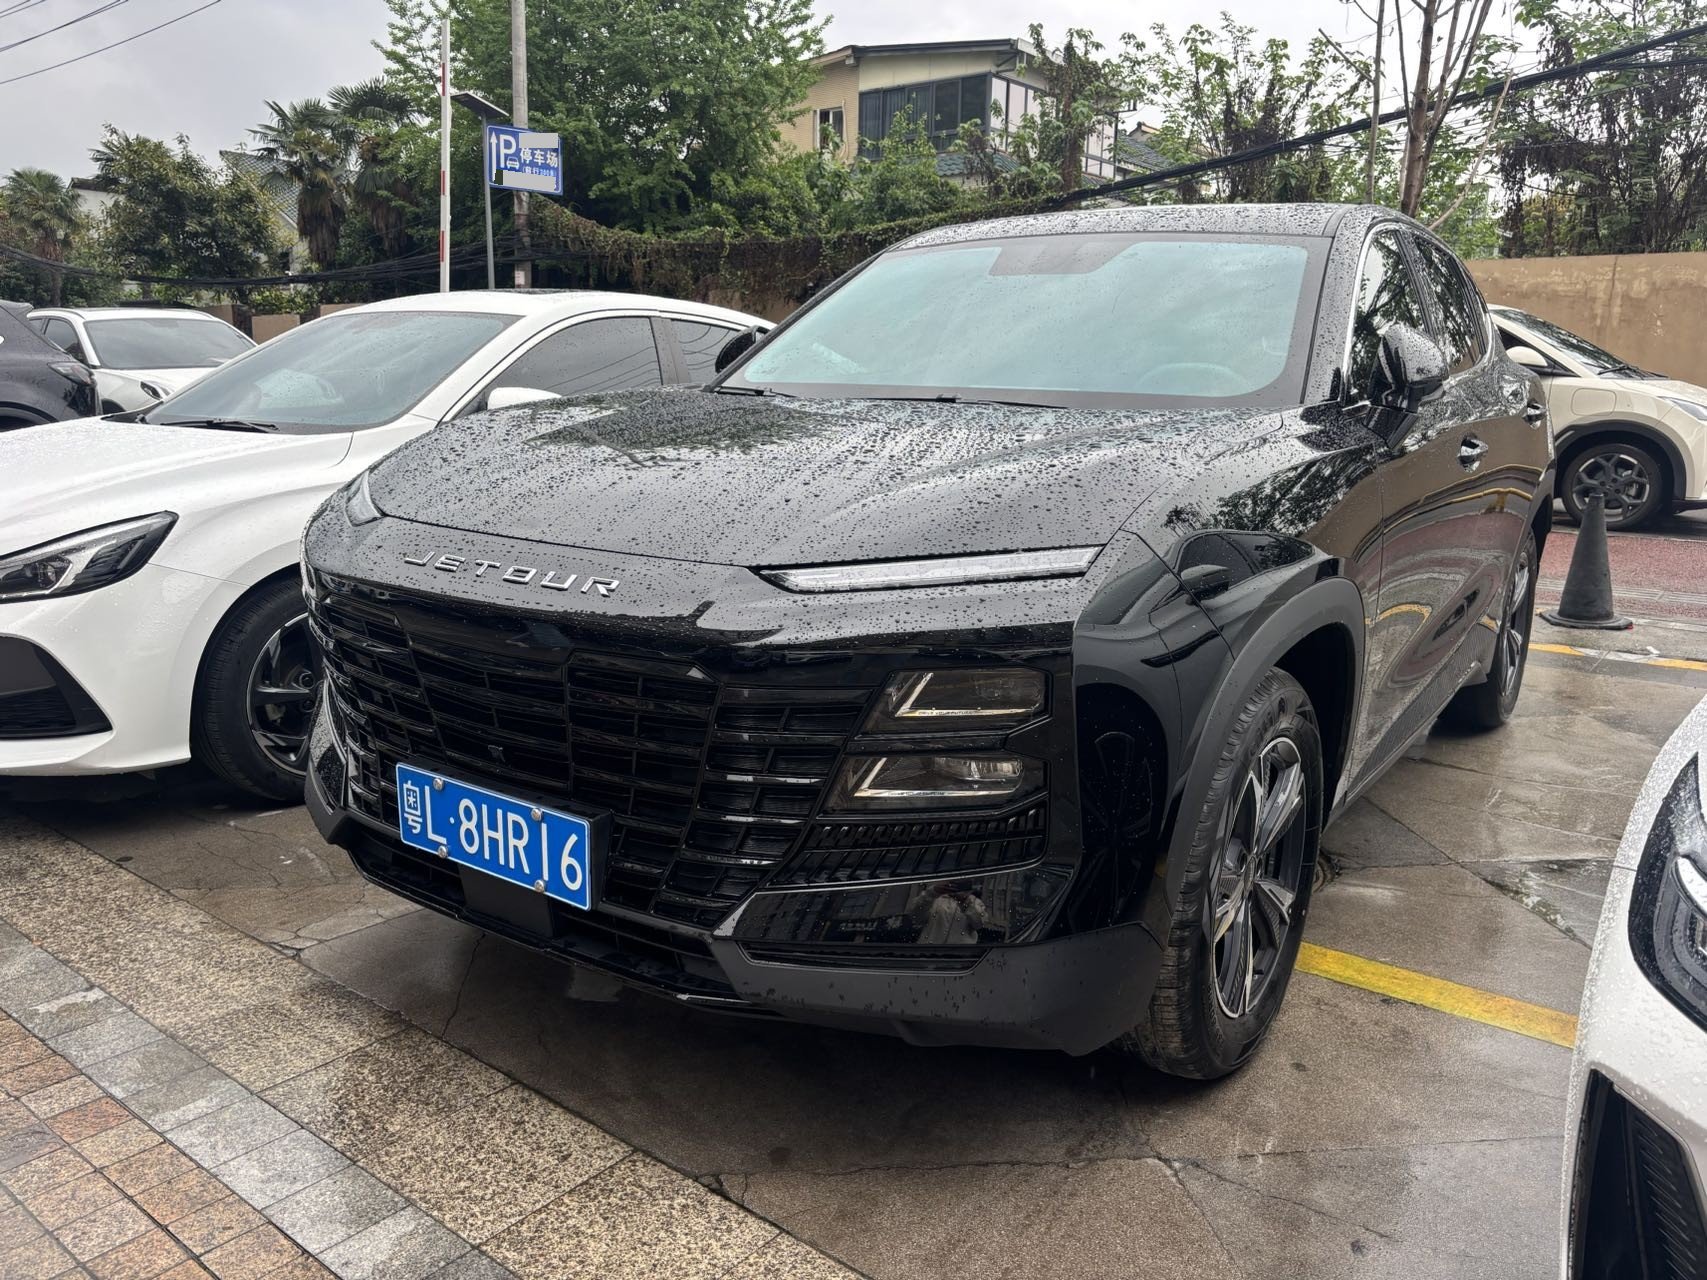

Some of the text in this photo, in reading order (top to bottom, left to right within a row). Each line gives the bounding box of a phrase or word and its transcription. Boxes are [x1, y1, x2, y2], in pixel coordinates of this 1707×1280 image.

[499, 134, 517, 169] P
[520, 147, 558, 168] 停车场
[404, 551, 620, 597] JETOUR
